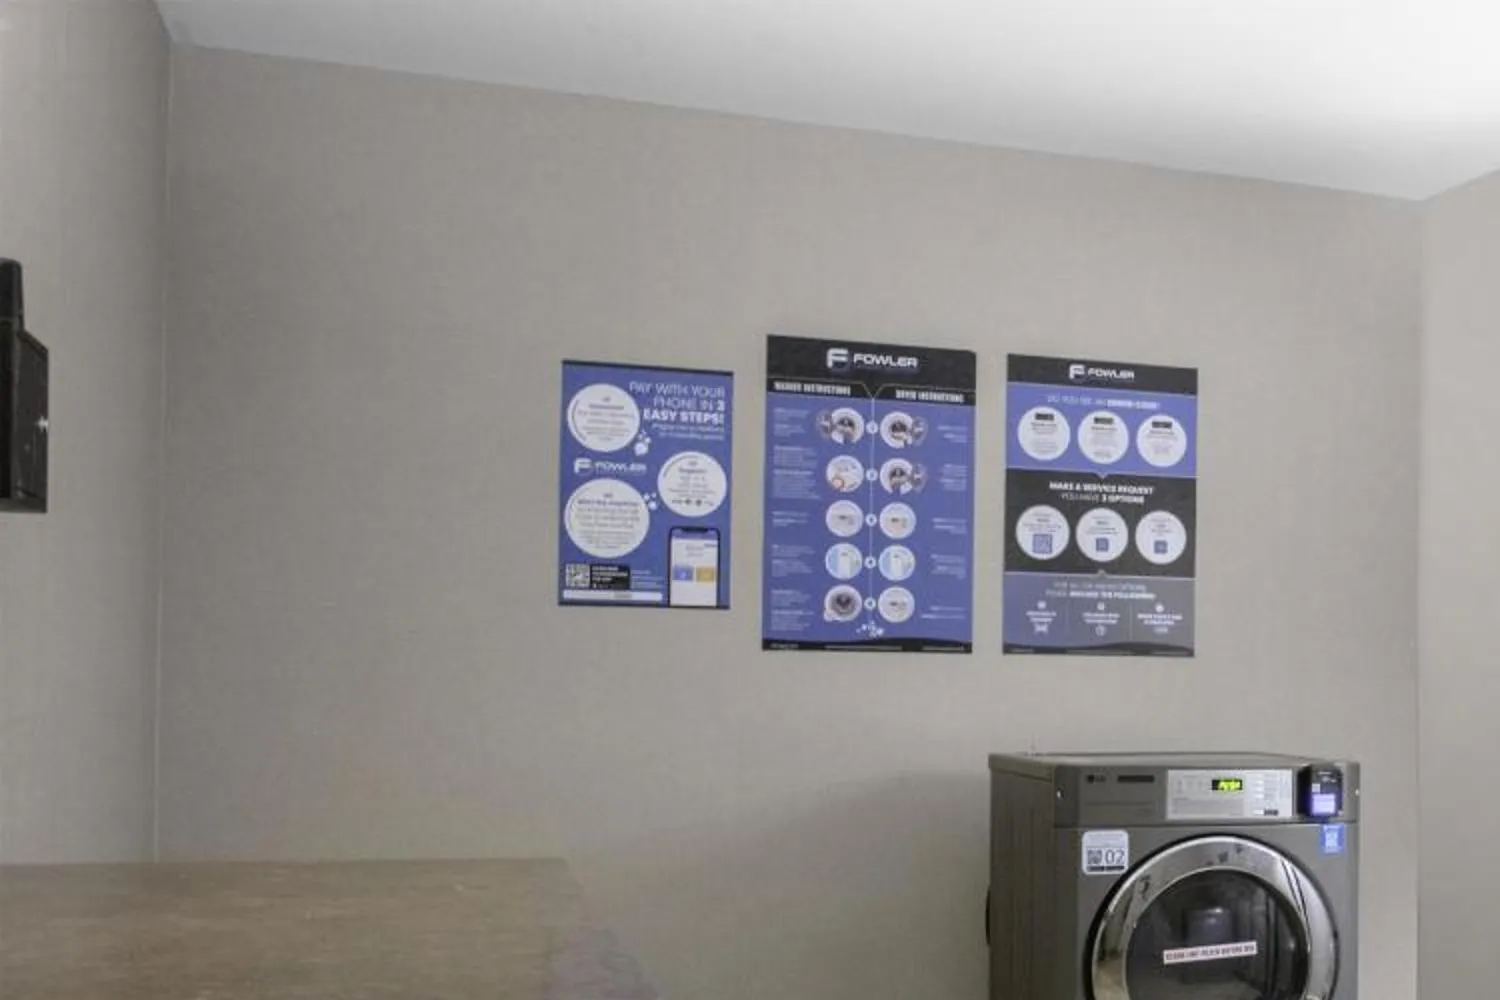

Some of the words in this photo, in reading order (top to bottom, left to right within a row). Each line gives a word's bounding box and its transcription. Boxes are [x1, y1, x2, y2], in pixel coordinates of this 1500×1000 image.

[853, 353, 919, 368] FOWLER
[1087, 367, 1135, 380] FOWLER
[628, 381, 653, 394] PAY
[655, 383, 689, 397] WITH
[690, 384, 725, 399] YOUR
[653, 395, 698, 410] PHONE
[643, 407, 677, 421] EASY
[680, 411, 725, 426] STEPS!
[595, 460, 647, 473] FOWLER
[1049, 480, 1074, 491] MAKE
[1083, 482, 1117, 493] SERVICE
[1118, 484, 1154, 495] REQUEST
[1108, 494, 1145, 505] OPTIONS
[1104, 849, 1125, 865] 02
